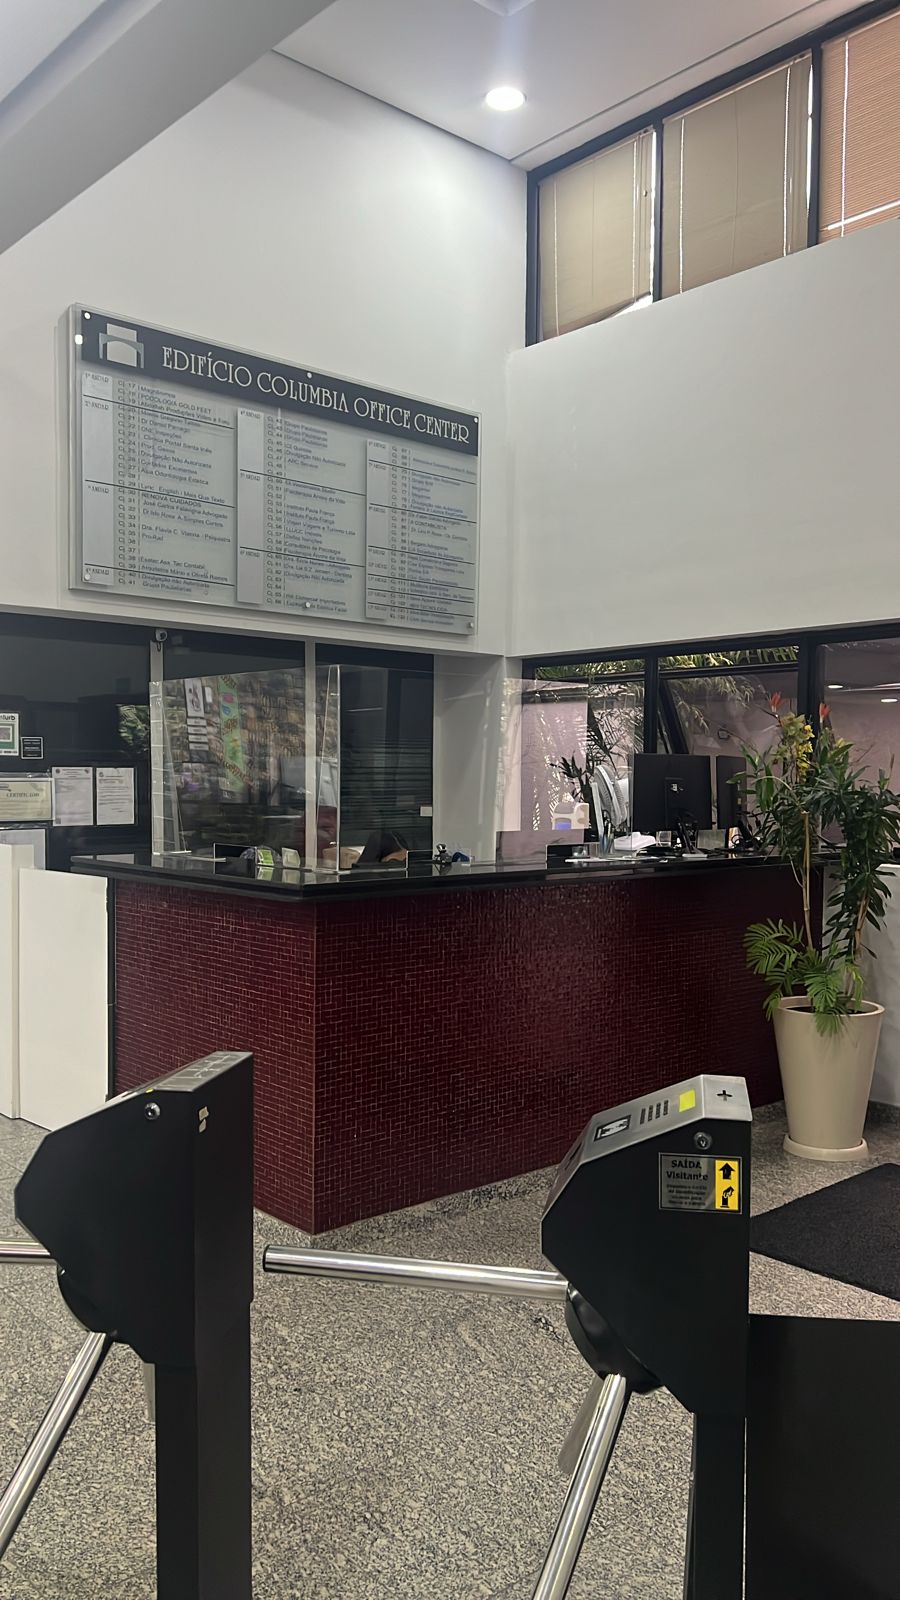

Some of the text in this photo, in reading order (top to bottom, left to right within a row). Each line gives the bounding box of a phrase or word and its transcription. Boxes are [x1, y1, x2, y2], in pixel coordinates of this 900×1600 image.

[162, 346, 470, 444] EDIFÍCIO COLUMBIA OFFICE CENTER
[141, 394, 176, 406] PODOLOGIA
[178, 402, 194, 411] GOLD
[196, 406, 211, 414] FEET
[141, 450, 170, 462] Divulgação
[141, 492, 167, 502] RENOVA
[169, 497, 201, 508] CUIDADOS
[671, 1158, 702, 1169] SAÍDA
[666, 1171, 709, 1181] Visitante
